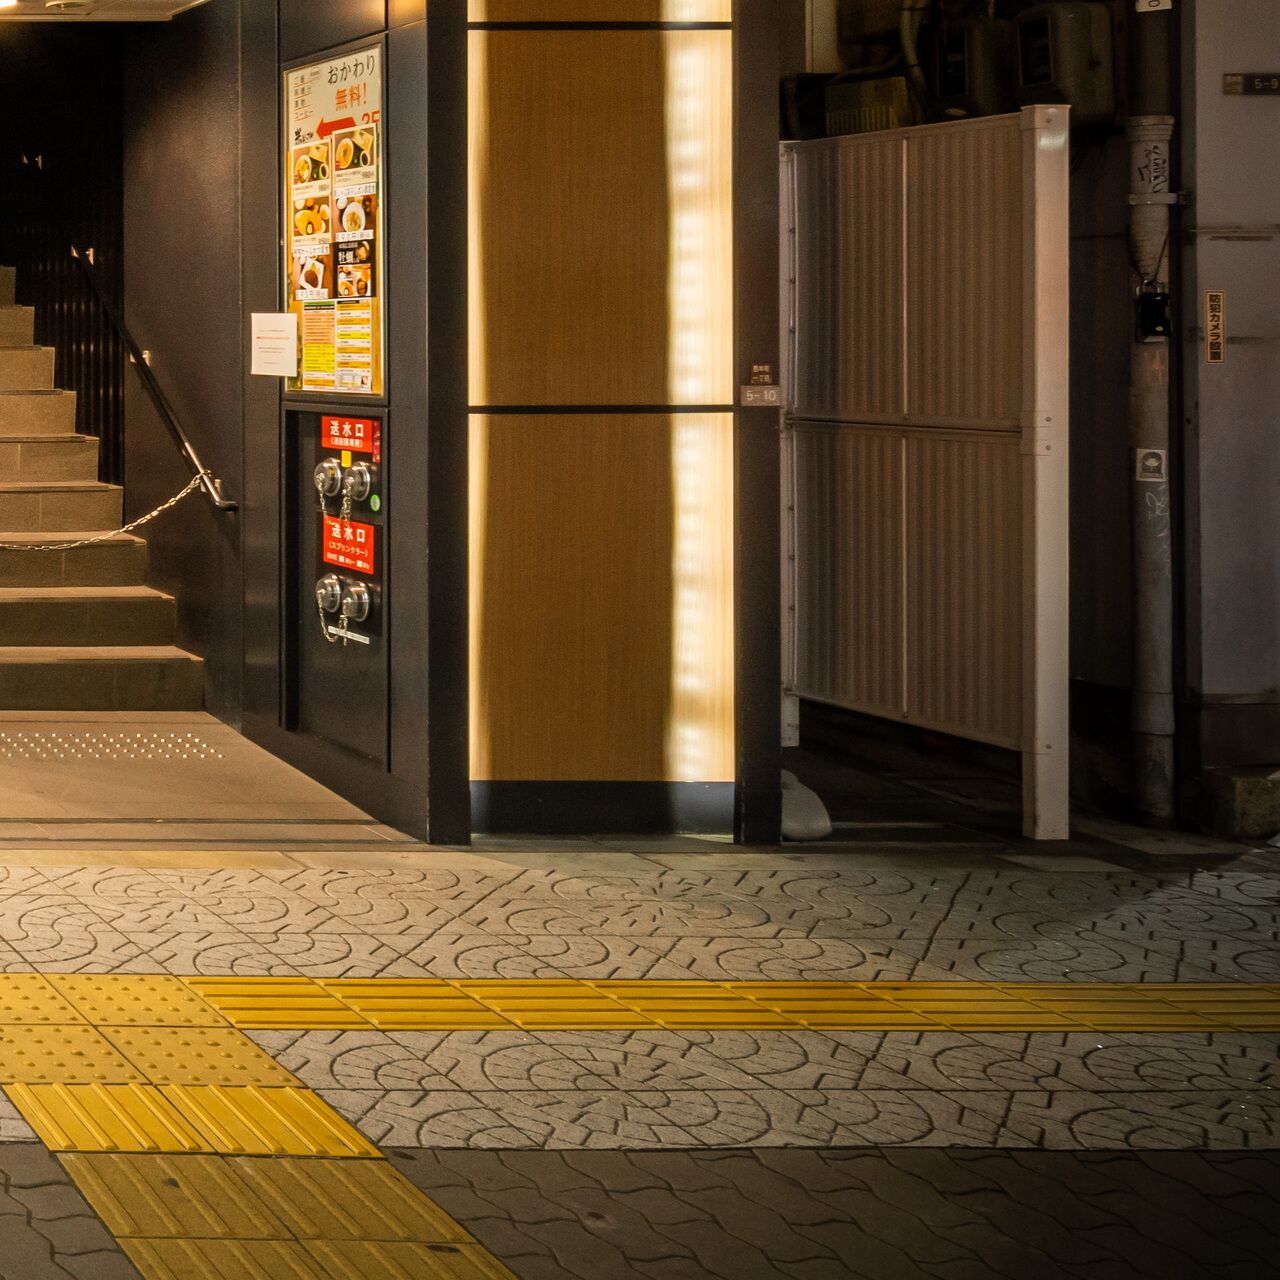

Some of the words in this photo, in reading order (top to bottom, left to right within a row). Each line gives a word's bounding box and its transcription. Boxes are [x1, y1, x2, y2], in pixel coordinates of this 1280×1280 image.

[327, 54, 375, 85] おかわり
[746, 390, 776, 401] 5-10
[329, 420, 365, 438] 送水口
[331, 524, 366, 543] 送水口
